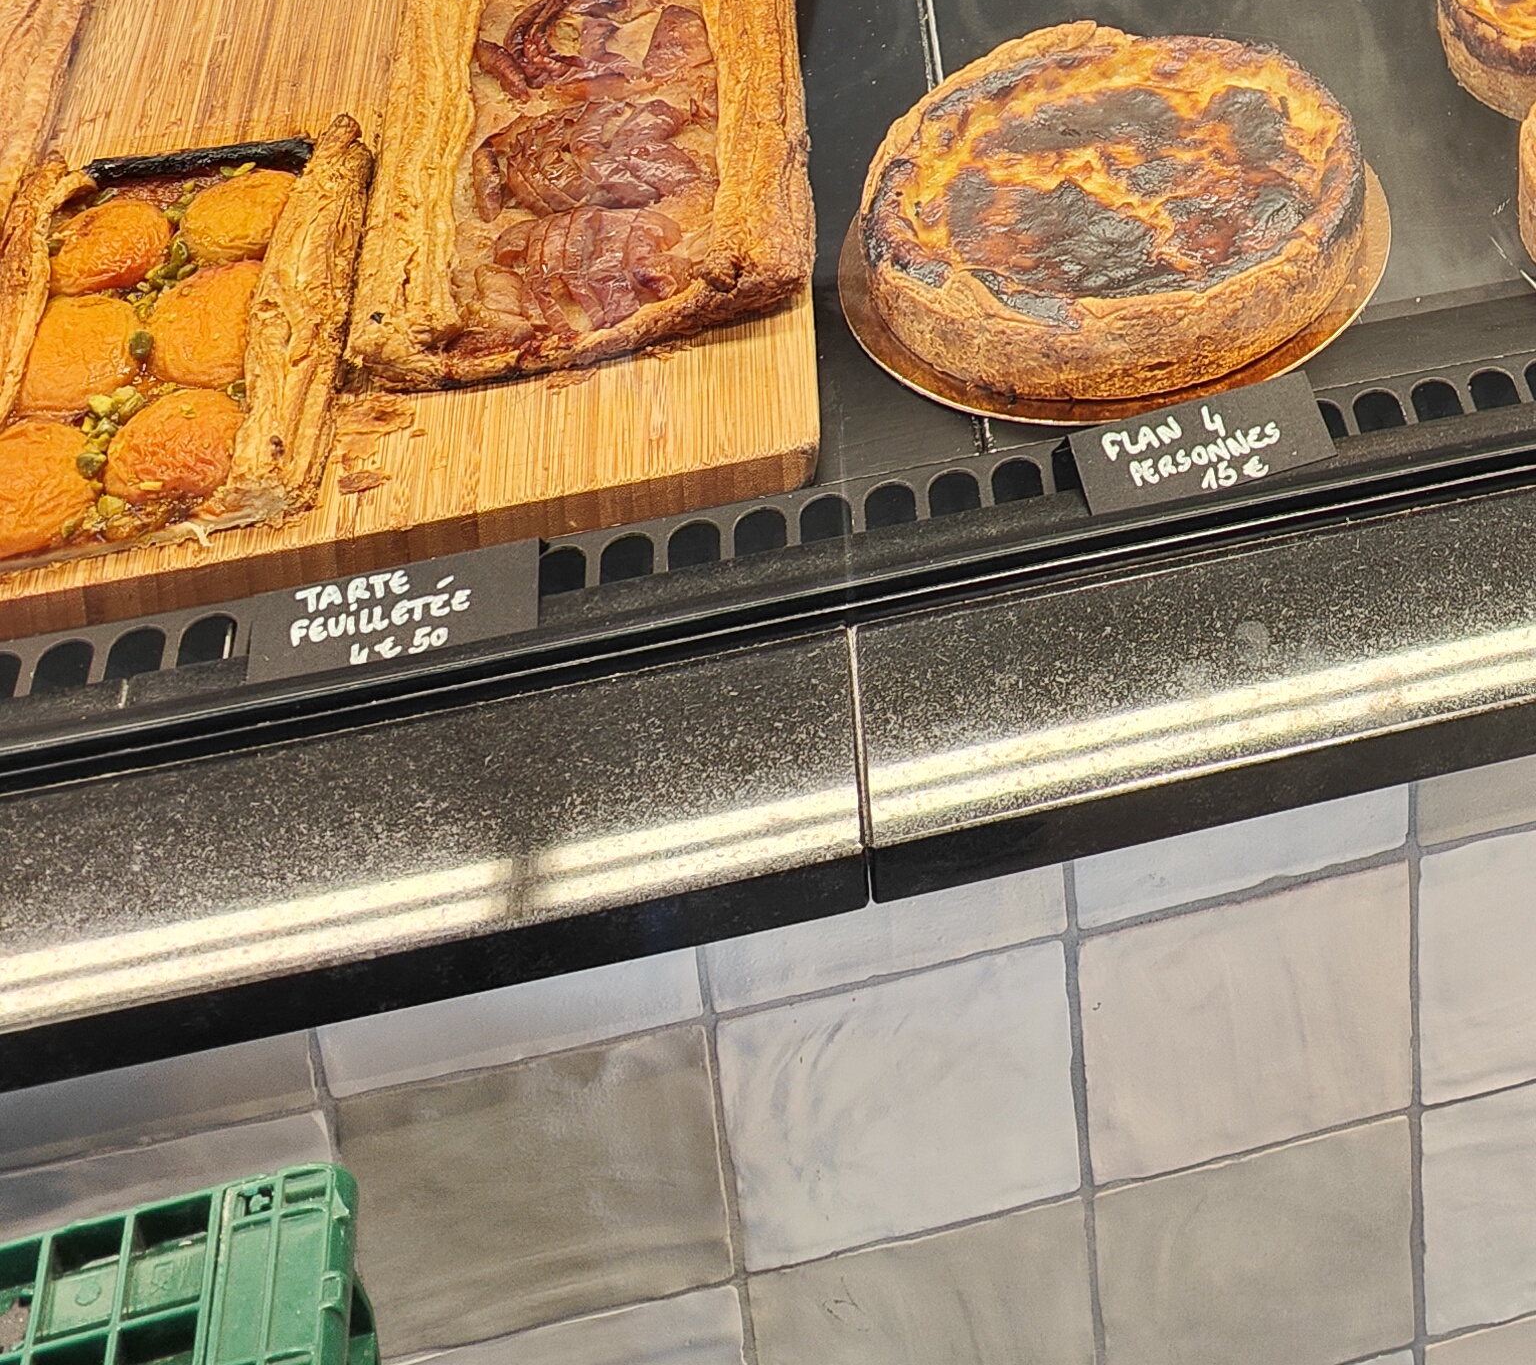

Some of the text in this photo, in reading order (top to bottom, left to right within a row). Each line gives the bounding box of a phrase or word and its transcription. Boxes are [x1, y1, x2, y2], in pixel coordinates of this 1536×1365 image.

[1101, 405, 1227, 462] FLAN 4
[1128, 421, 1281, 487] PERSONNES
[294, 570, 411, 614] TARTE
